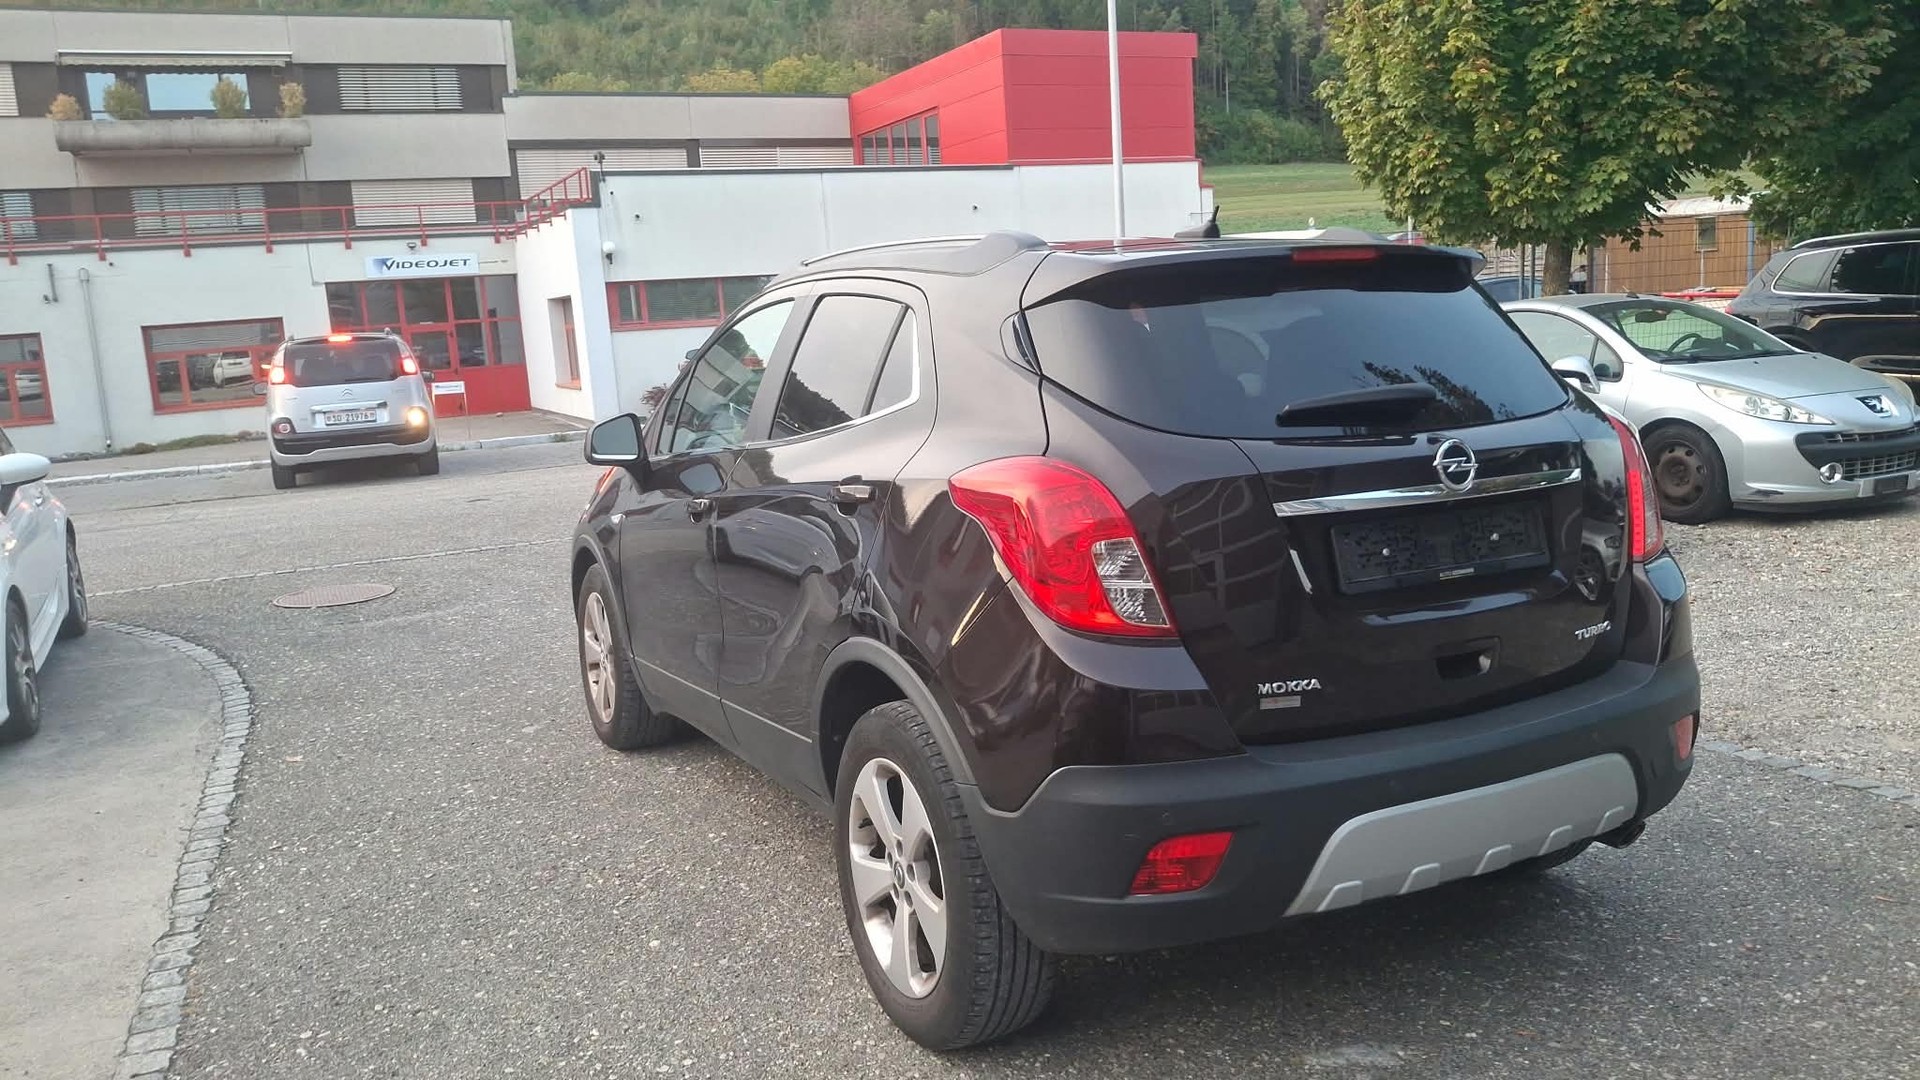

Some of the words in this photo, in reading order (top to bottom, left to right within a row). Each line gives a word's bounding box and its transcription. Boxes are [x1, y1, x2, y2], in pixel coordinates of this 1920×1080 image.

[383, 258, 471, 271] VIDEOJET
[1574, 620, 1612, 640] TURBO
[1257, 679, 1321, 694] MOKKA
